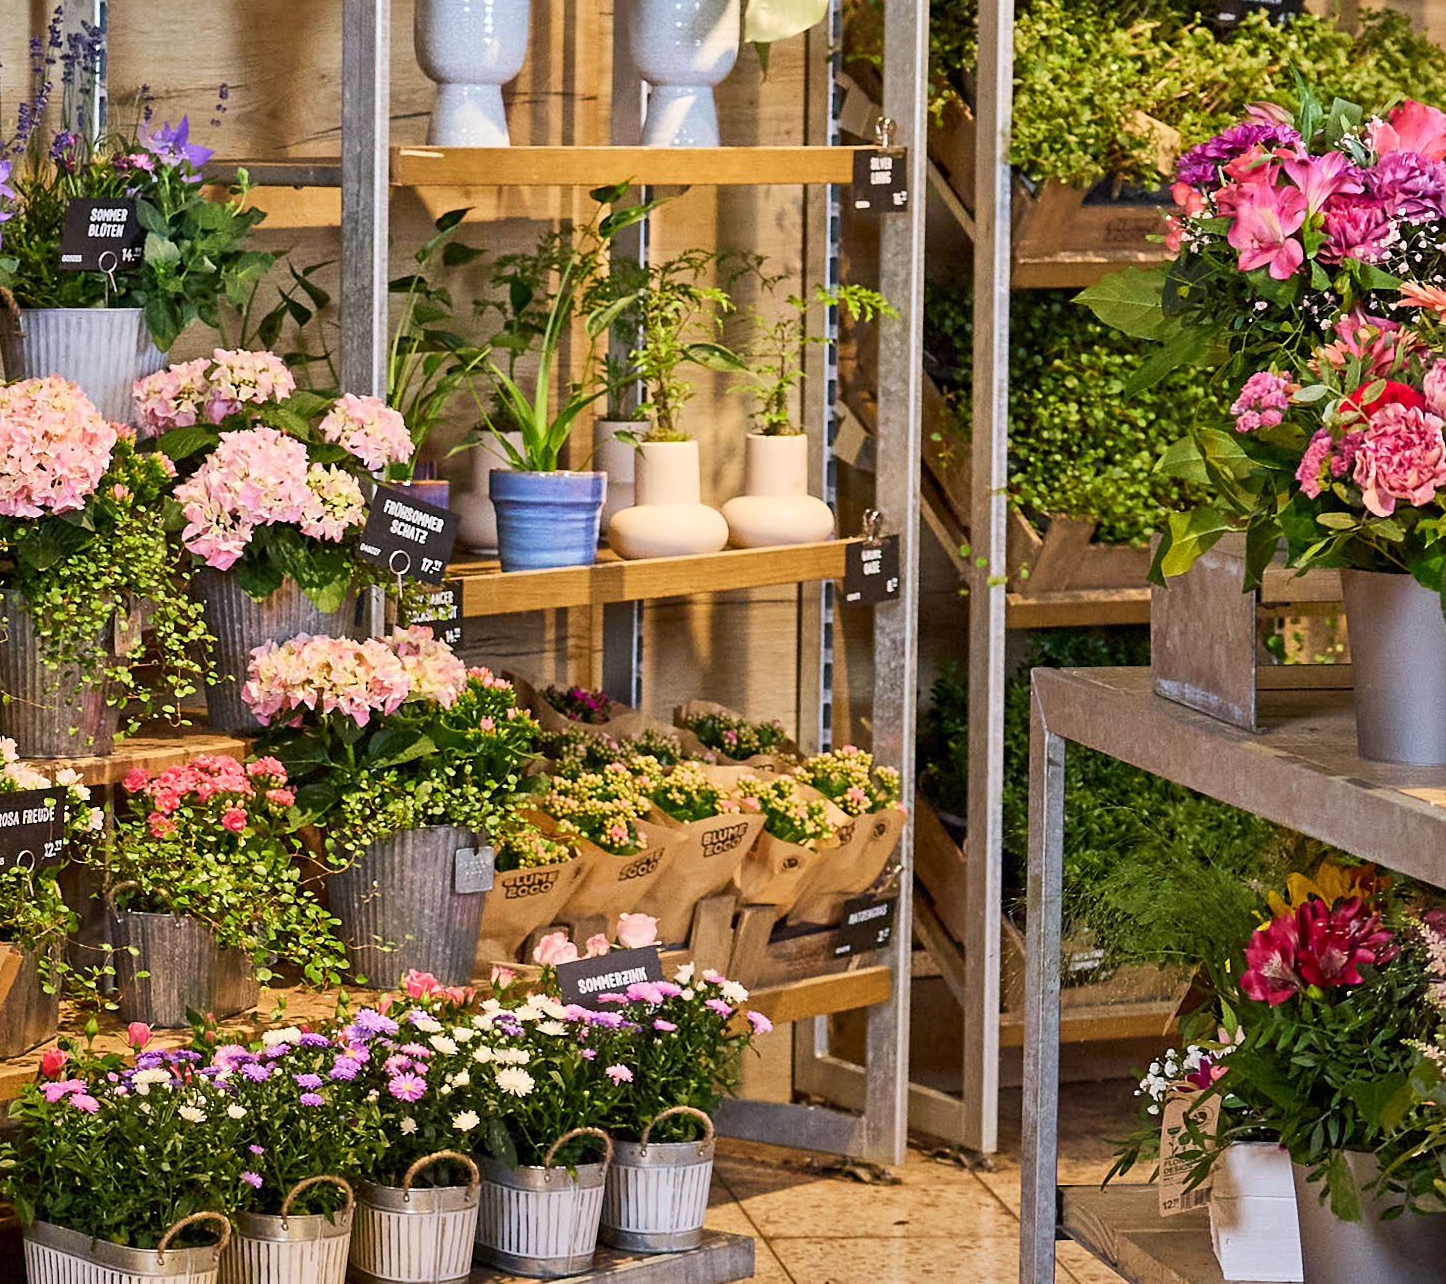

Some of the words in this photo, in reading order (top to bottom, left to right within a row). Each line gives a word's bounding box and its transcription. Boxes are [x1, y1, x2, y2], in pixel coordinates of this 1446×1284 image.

[90, 208, 128, 222] SOMMER
[88, 223, 125, 237] BLÜTEN
[383, 499, 445, 533] FRÜHSOMMER
[389, 519, 429, 544] SCHATZ
[22, 806, 56, 825] FREUDE
[701, 822, 749, 846] BLUME
[502, 869, 560, 887] BLUME
[505, 881, 553, 899] 2000
[577, 967, 648, 994] SOMMERZINK
